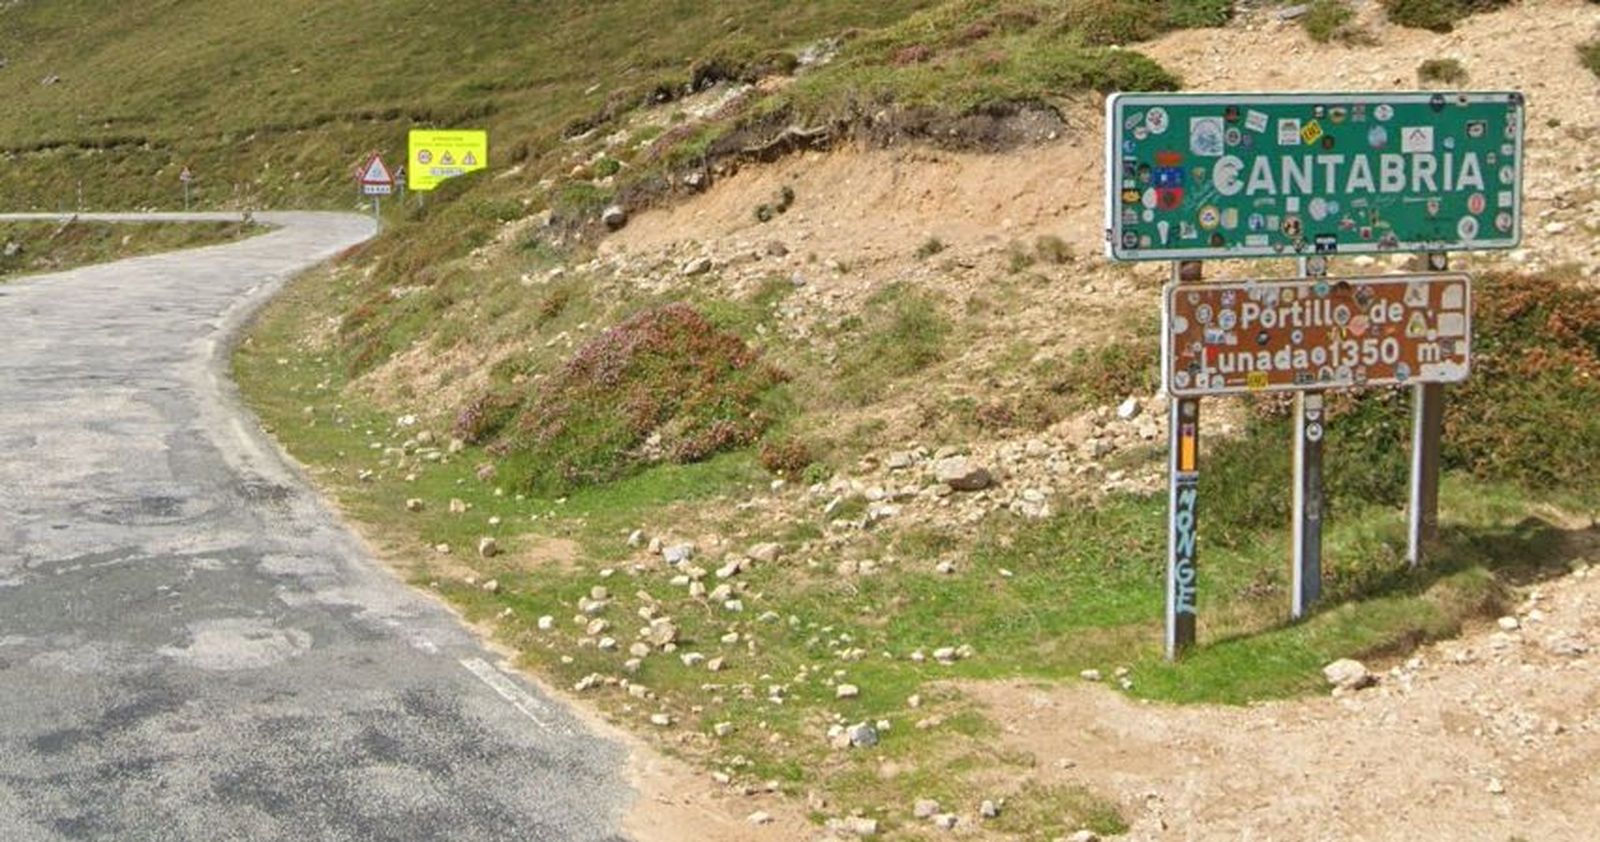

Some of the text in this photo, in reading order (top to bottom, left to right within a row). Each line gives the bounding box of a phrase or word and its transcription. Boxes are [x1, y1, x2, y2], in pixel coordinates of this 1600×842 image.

[1213, 152, 1485, 197] CANTABRIA
[1241, 299, 1404, 329] Portillo de
[1201, 337, 1440, 374] Lunada 1350 m
[1175, 488, 1197, 615] MONGE
